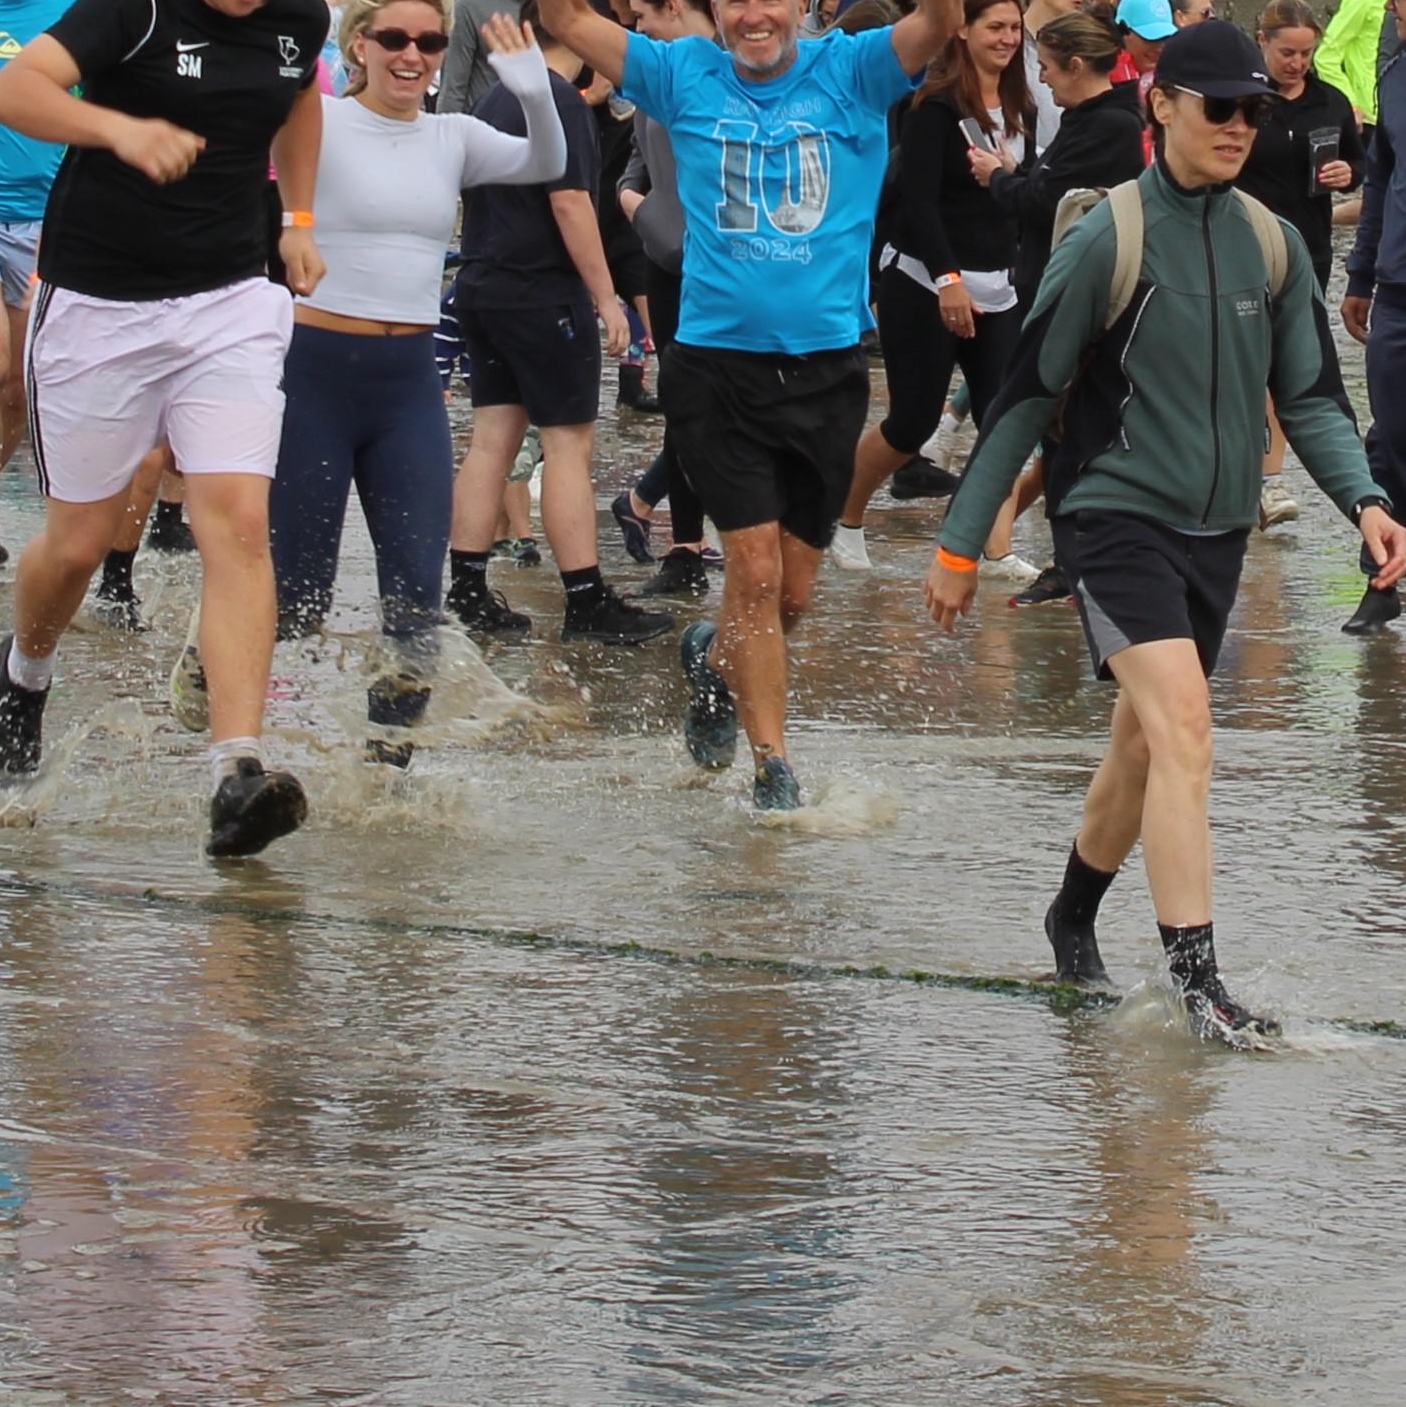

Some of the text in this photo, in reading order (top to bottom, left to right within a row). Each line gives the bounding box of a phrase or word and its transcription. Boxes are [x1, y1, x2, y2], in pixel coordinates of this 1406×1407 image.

[177, 53, 202, 79] SM
[713, 119, 831, 236] 10
[731, 237, 813, 265] 2024
